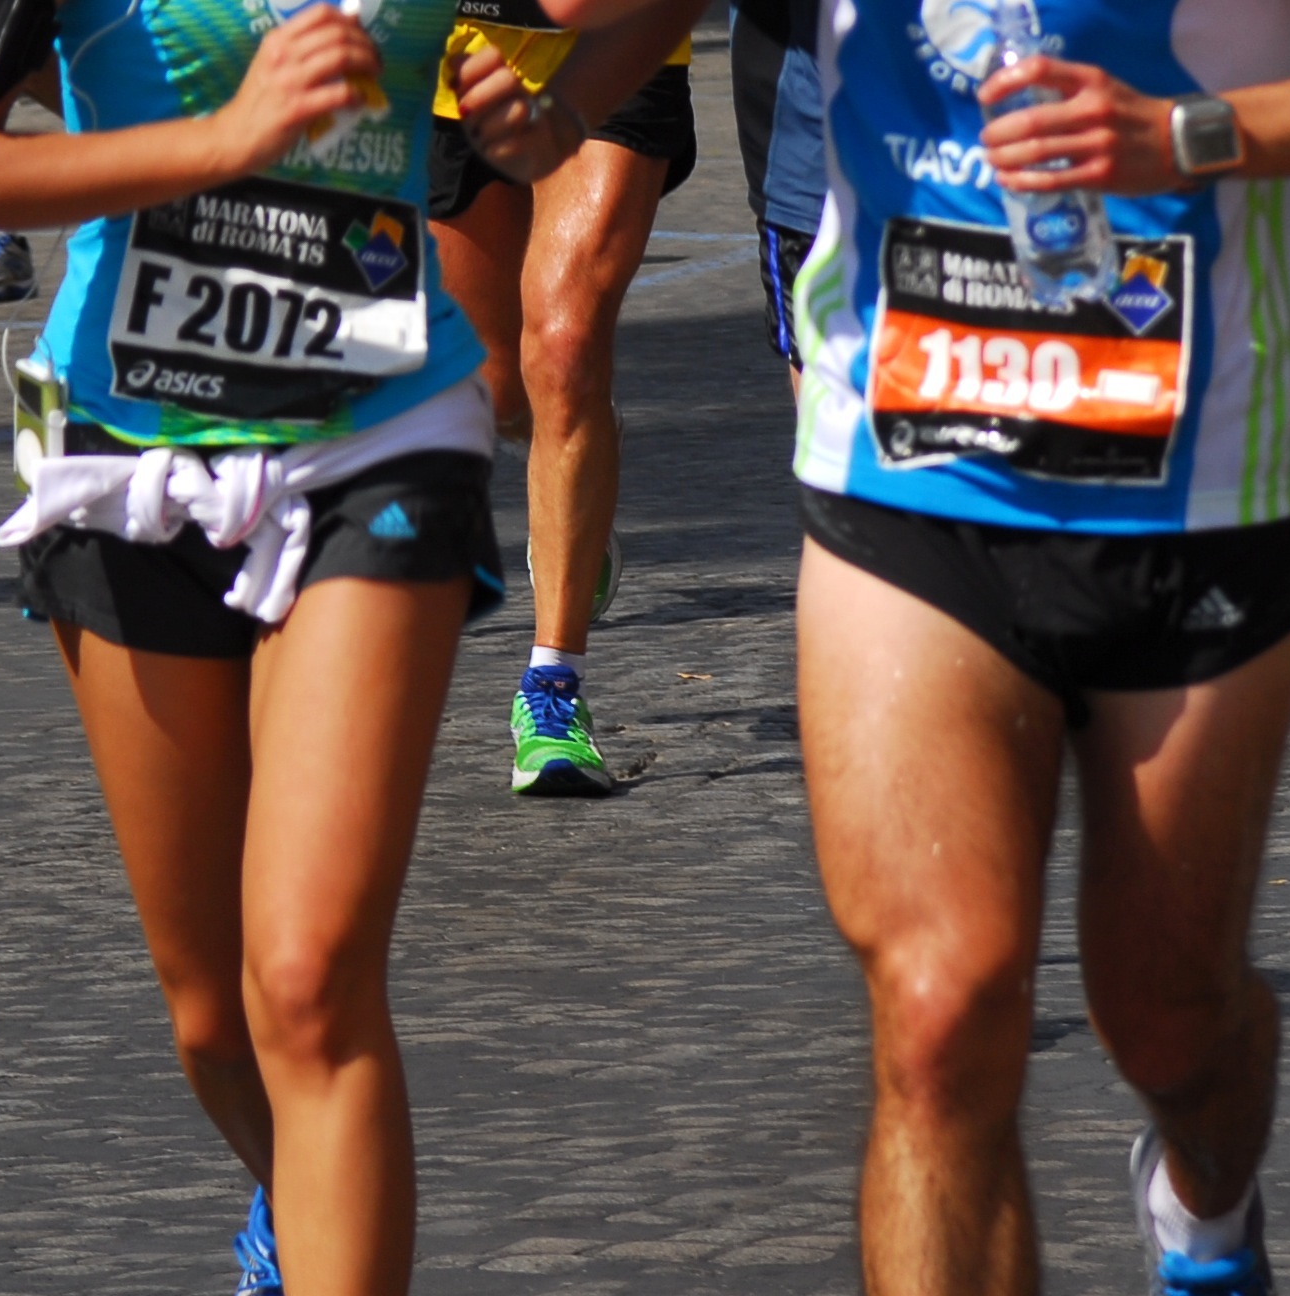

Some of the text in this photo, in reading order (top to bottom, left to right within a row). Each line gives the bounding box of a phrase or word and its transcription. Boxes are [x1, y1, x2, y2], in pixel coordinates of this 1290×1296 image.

[195, 195, 329, 241] MARATONA
[219, 224, 292, 261] ROMA
[126, 261, 345, 360] F 2072
[154, 369, 225, 398] asics
[919, 329, 1080, 412] 1130
